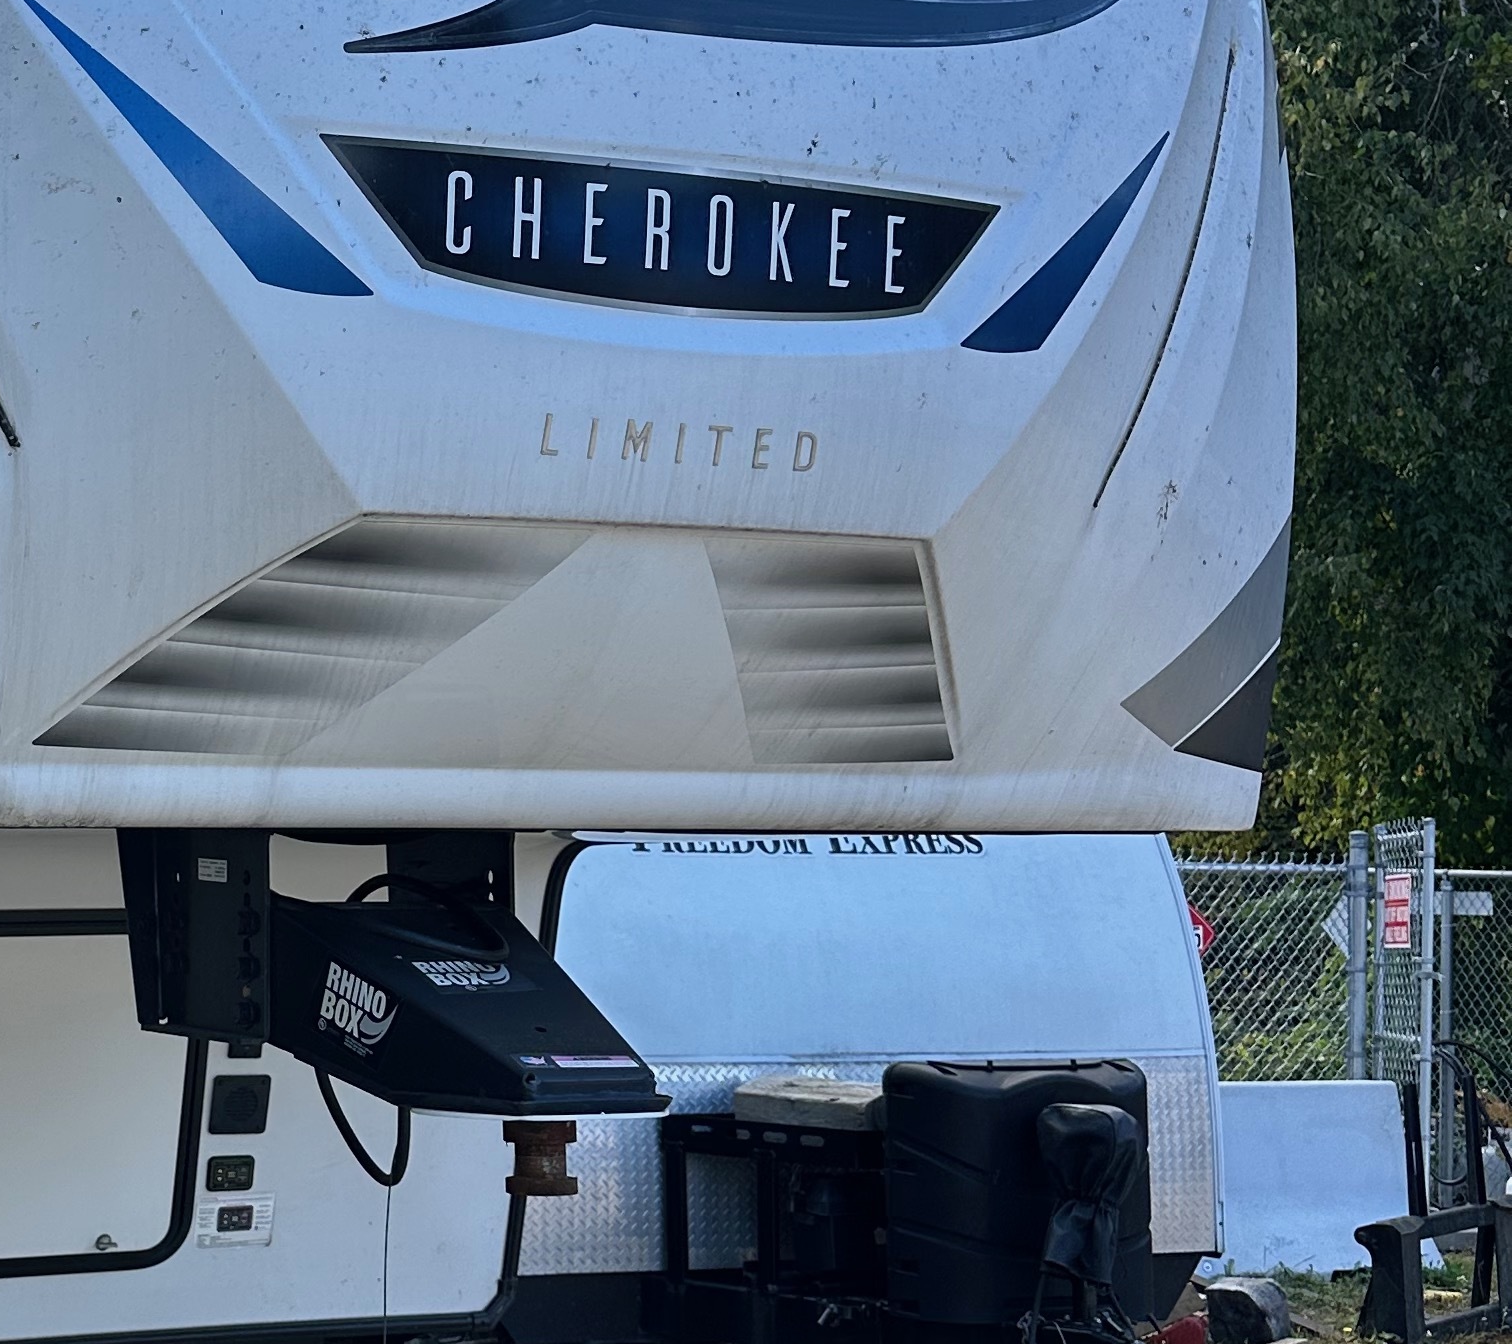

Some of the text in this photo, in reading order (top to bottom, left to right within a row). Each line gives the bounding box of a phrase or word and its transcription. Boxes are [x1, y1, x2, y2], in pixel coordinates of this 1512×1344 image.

[444, 169, 907, 295] CHEROKEE
[539, 412, 820, 473] LIMITED
[828, 833, 983, 855] EXPRESS
[326, 961, 386, 1019] RHINO
[411, 960, 496, 974] RHINO
[426, 972, 490, 986] BOX
[320, 988, 363, 1038] BOX
